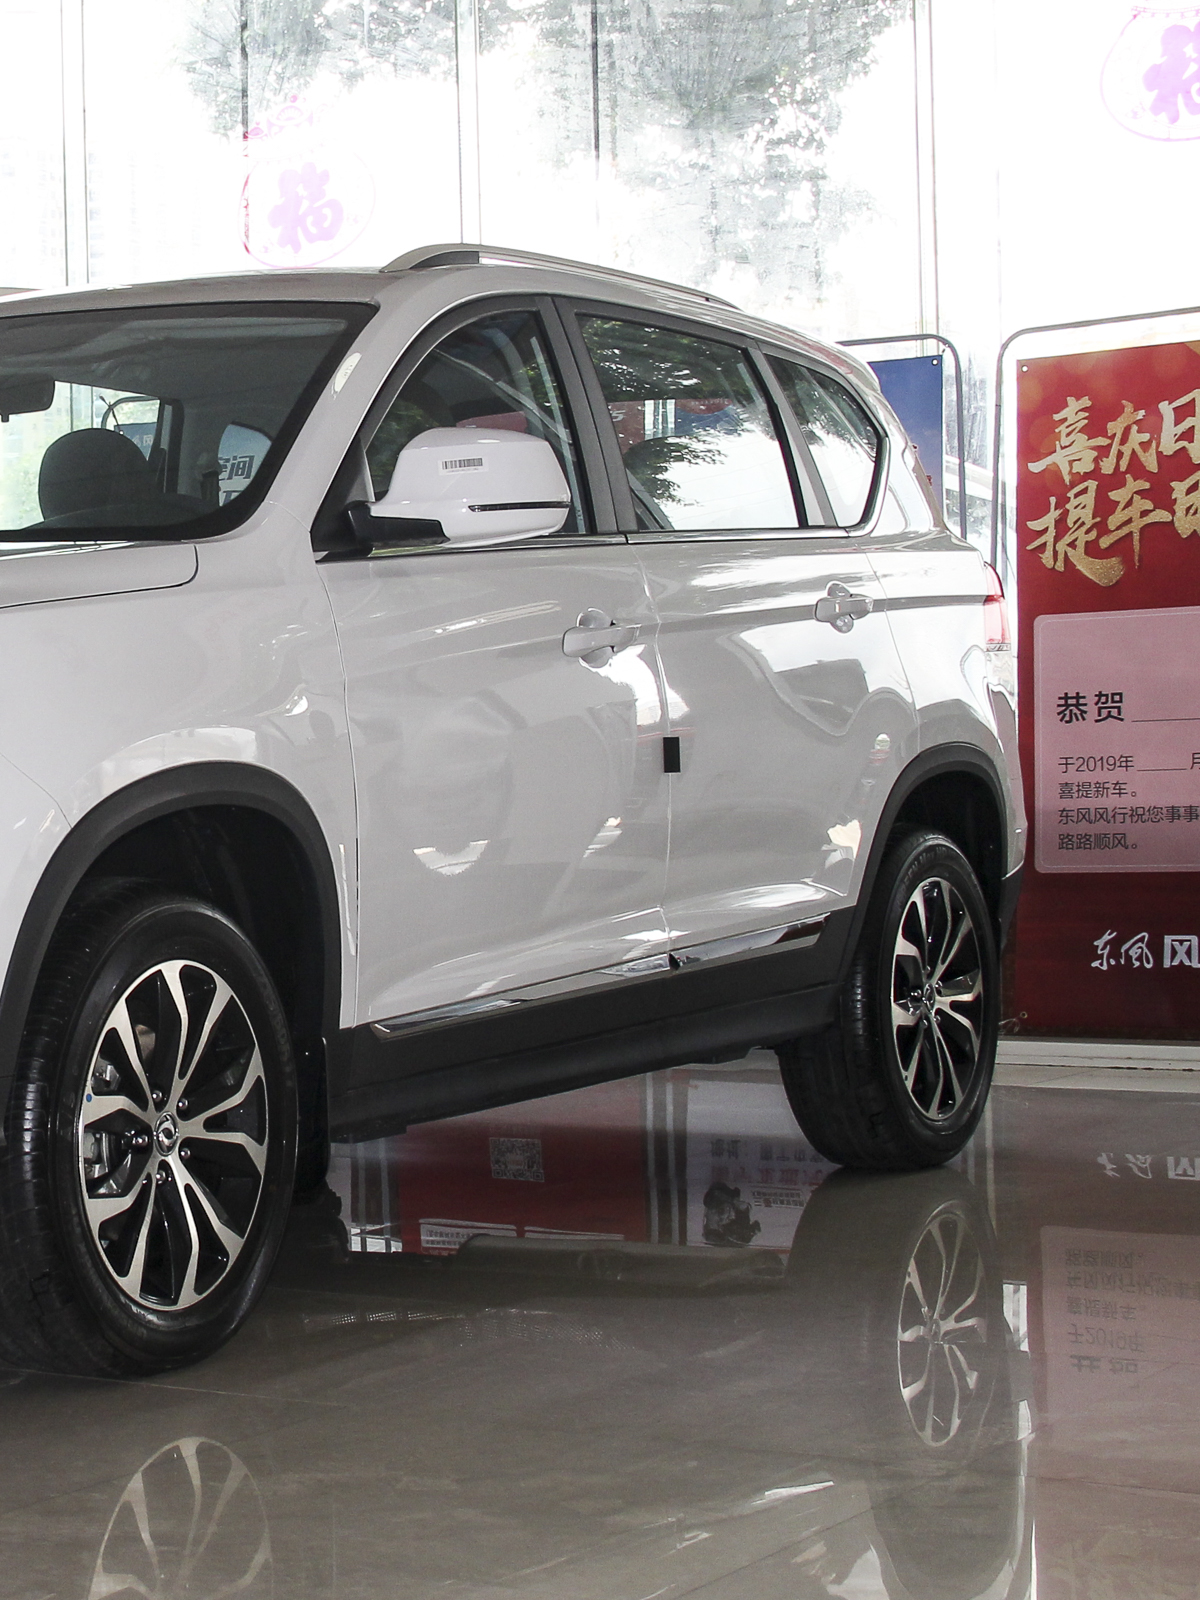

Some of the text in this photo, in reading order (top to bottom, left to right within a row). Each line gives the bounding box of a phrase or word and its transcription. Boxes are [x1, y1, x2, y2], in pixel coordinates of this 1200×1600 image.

[267, 162, 344, 254] 福
[1056, 690, 1125, 724] 恭贺
[1057, 754, 1135, 774] 于2019年
[1058, 780, 1137, 800] 喜提新车。
[1058, 804, 1200, 825] 东风风行祝您事事
[1058, 832, 1138, 851] 路路顺风。
